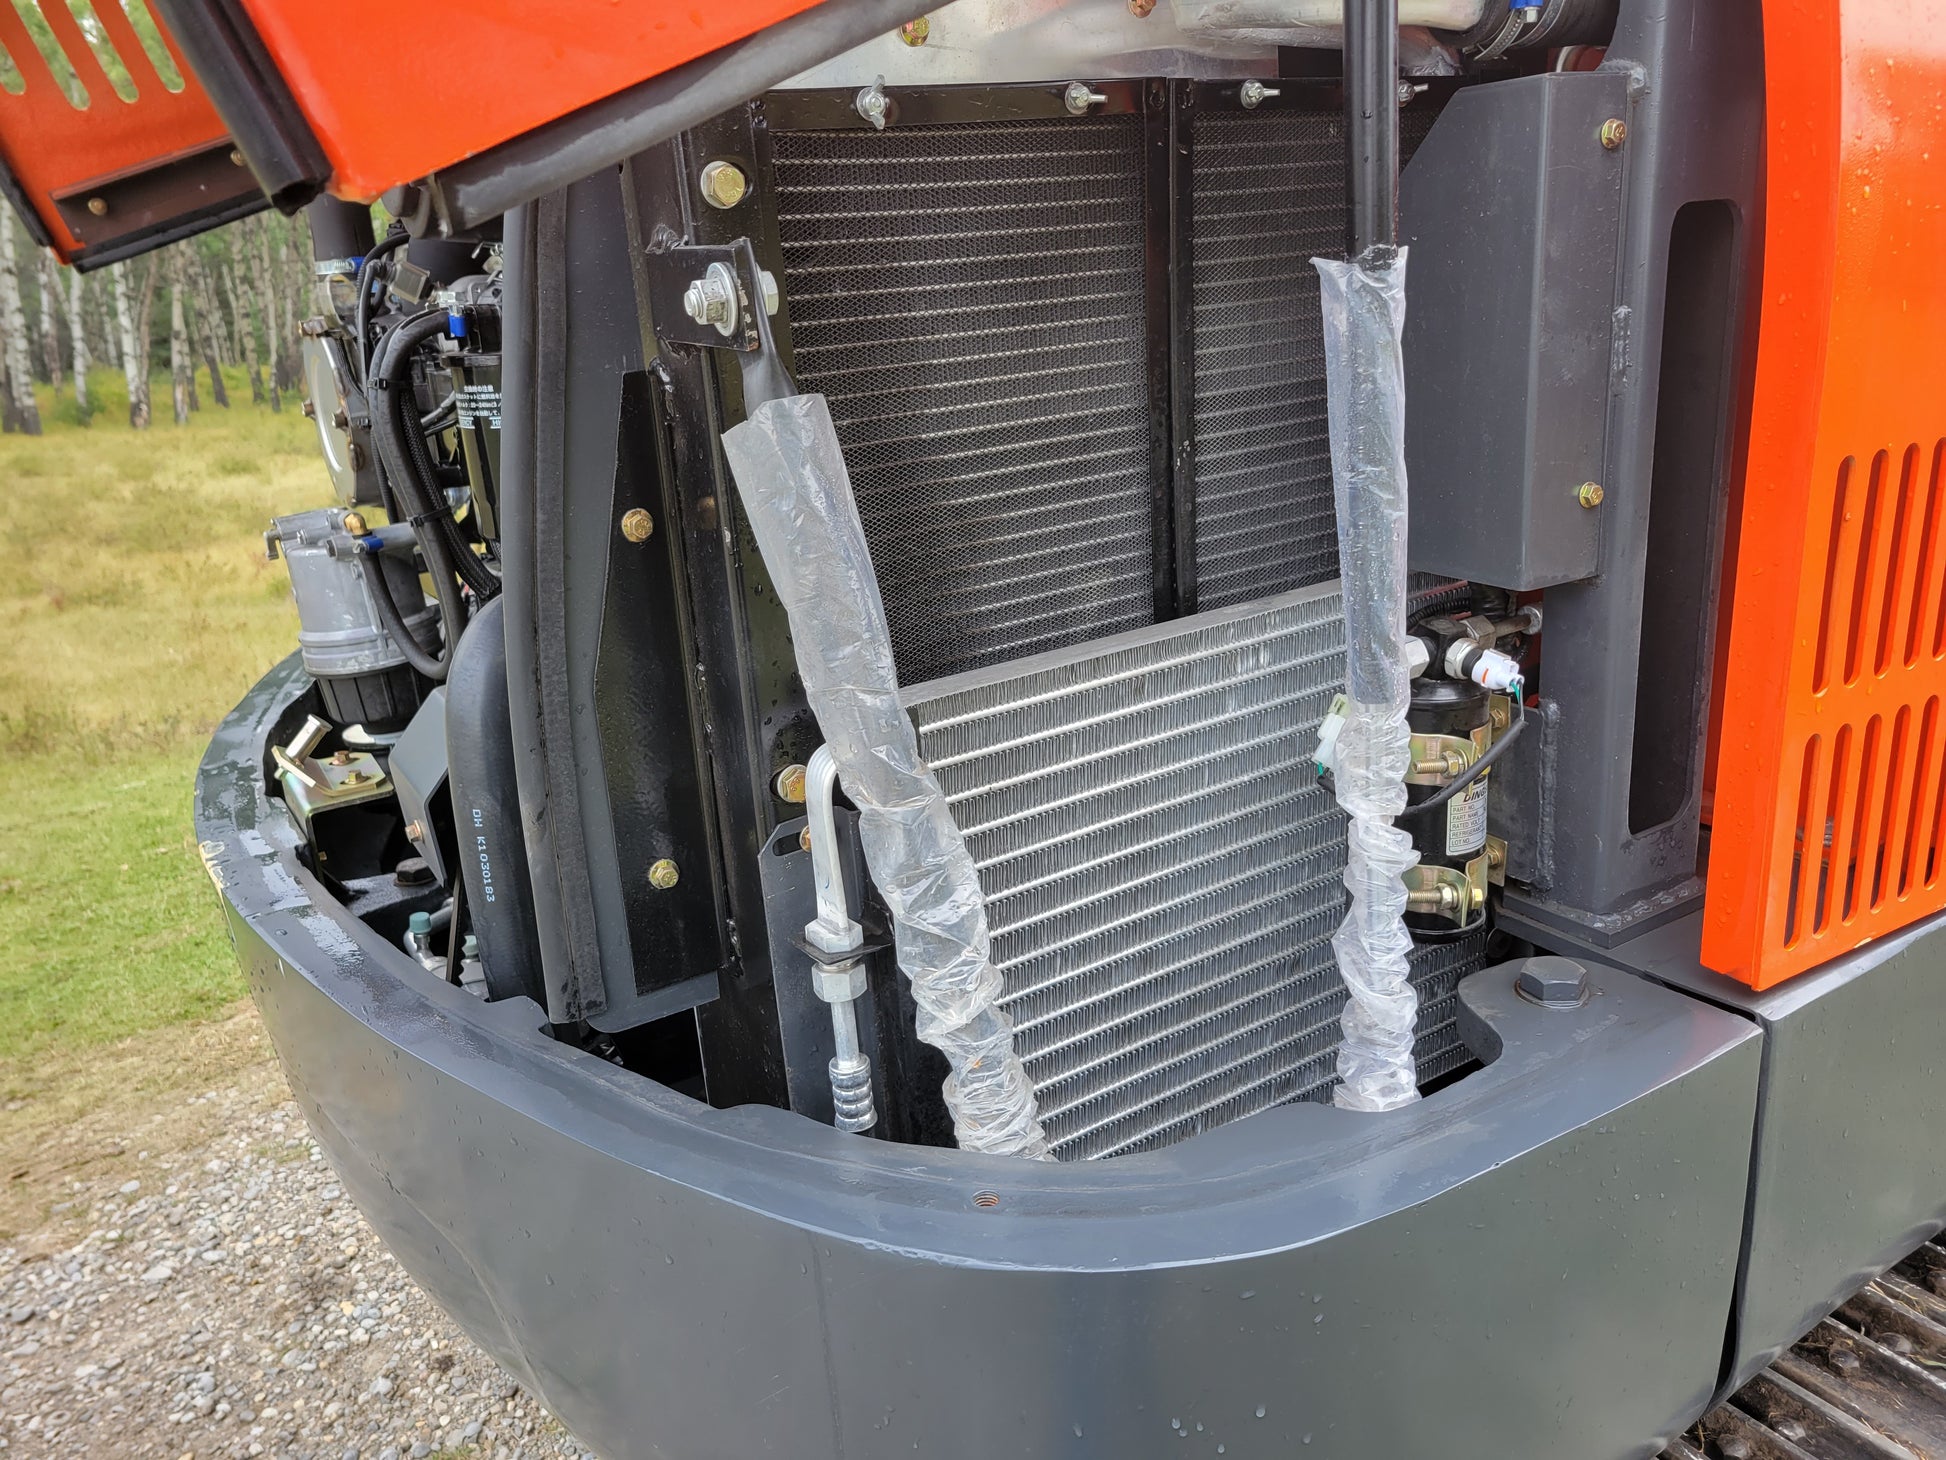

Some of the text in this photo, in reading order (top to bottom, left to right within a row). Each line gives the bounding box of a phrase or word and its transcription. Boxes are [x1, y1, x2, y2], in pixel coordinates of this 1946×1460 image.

[1452, 822, 1469, 830] RATED
[472, 808, 495, 902] DH K1030183
